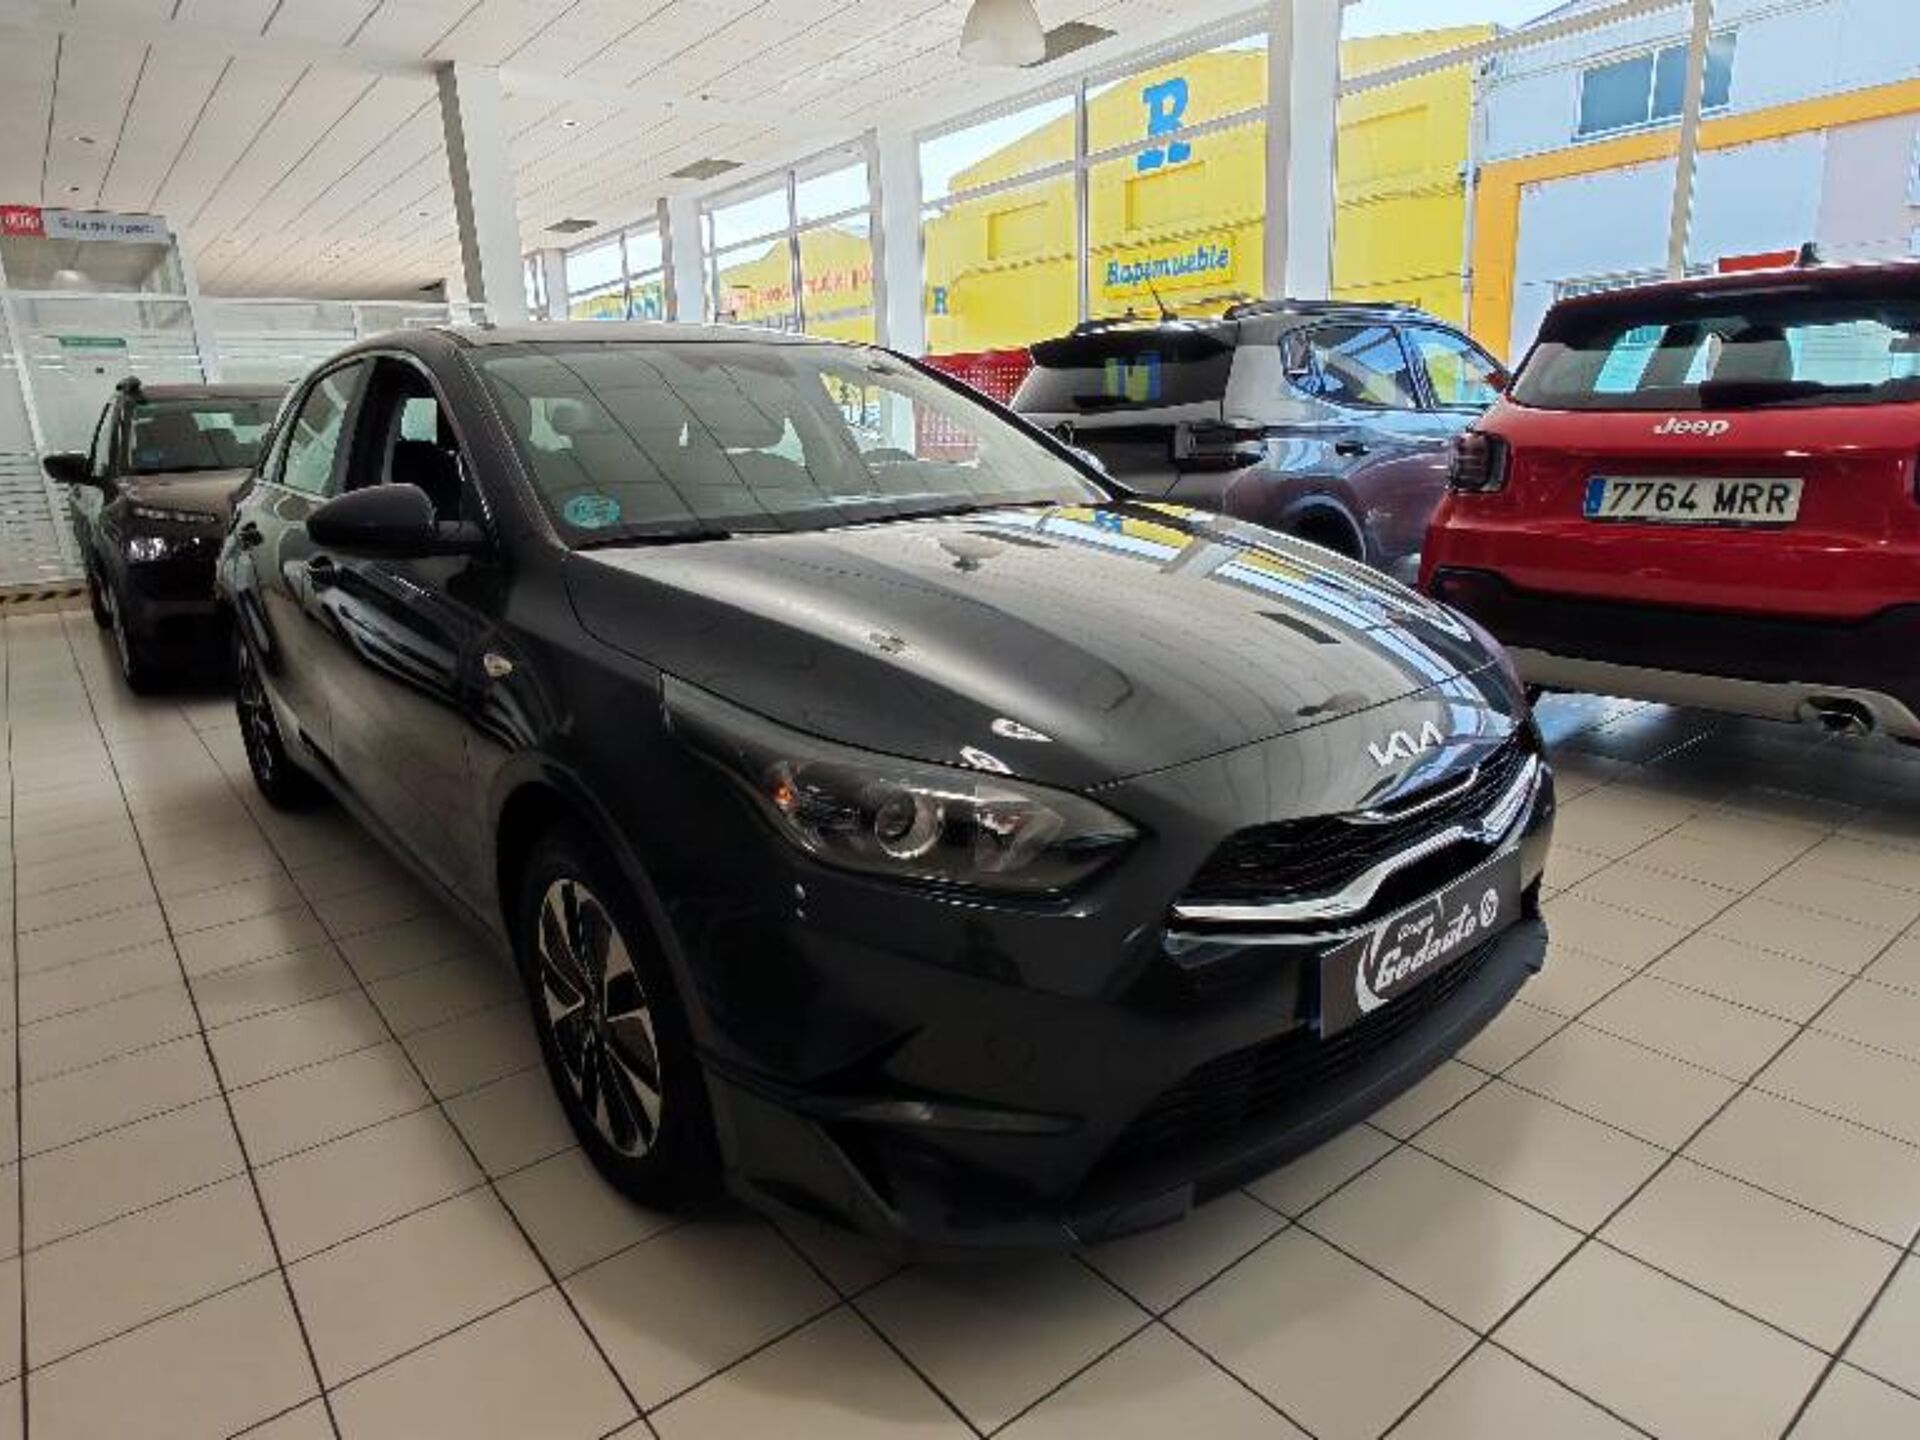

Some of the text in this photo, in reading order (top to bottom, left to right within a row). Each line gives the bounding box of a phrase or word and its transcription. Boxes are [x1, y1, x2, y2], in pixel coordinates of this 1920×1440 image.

[1106, 245, 1230, 287] Rapimueble
[1653, 417, 1730, 436] Jeep
[1608, 482, 1791, 514] 7764 MRR
[1368, 720, 1444, 767] KIA
